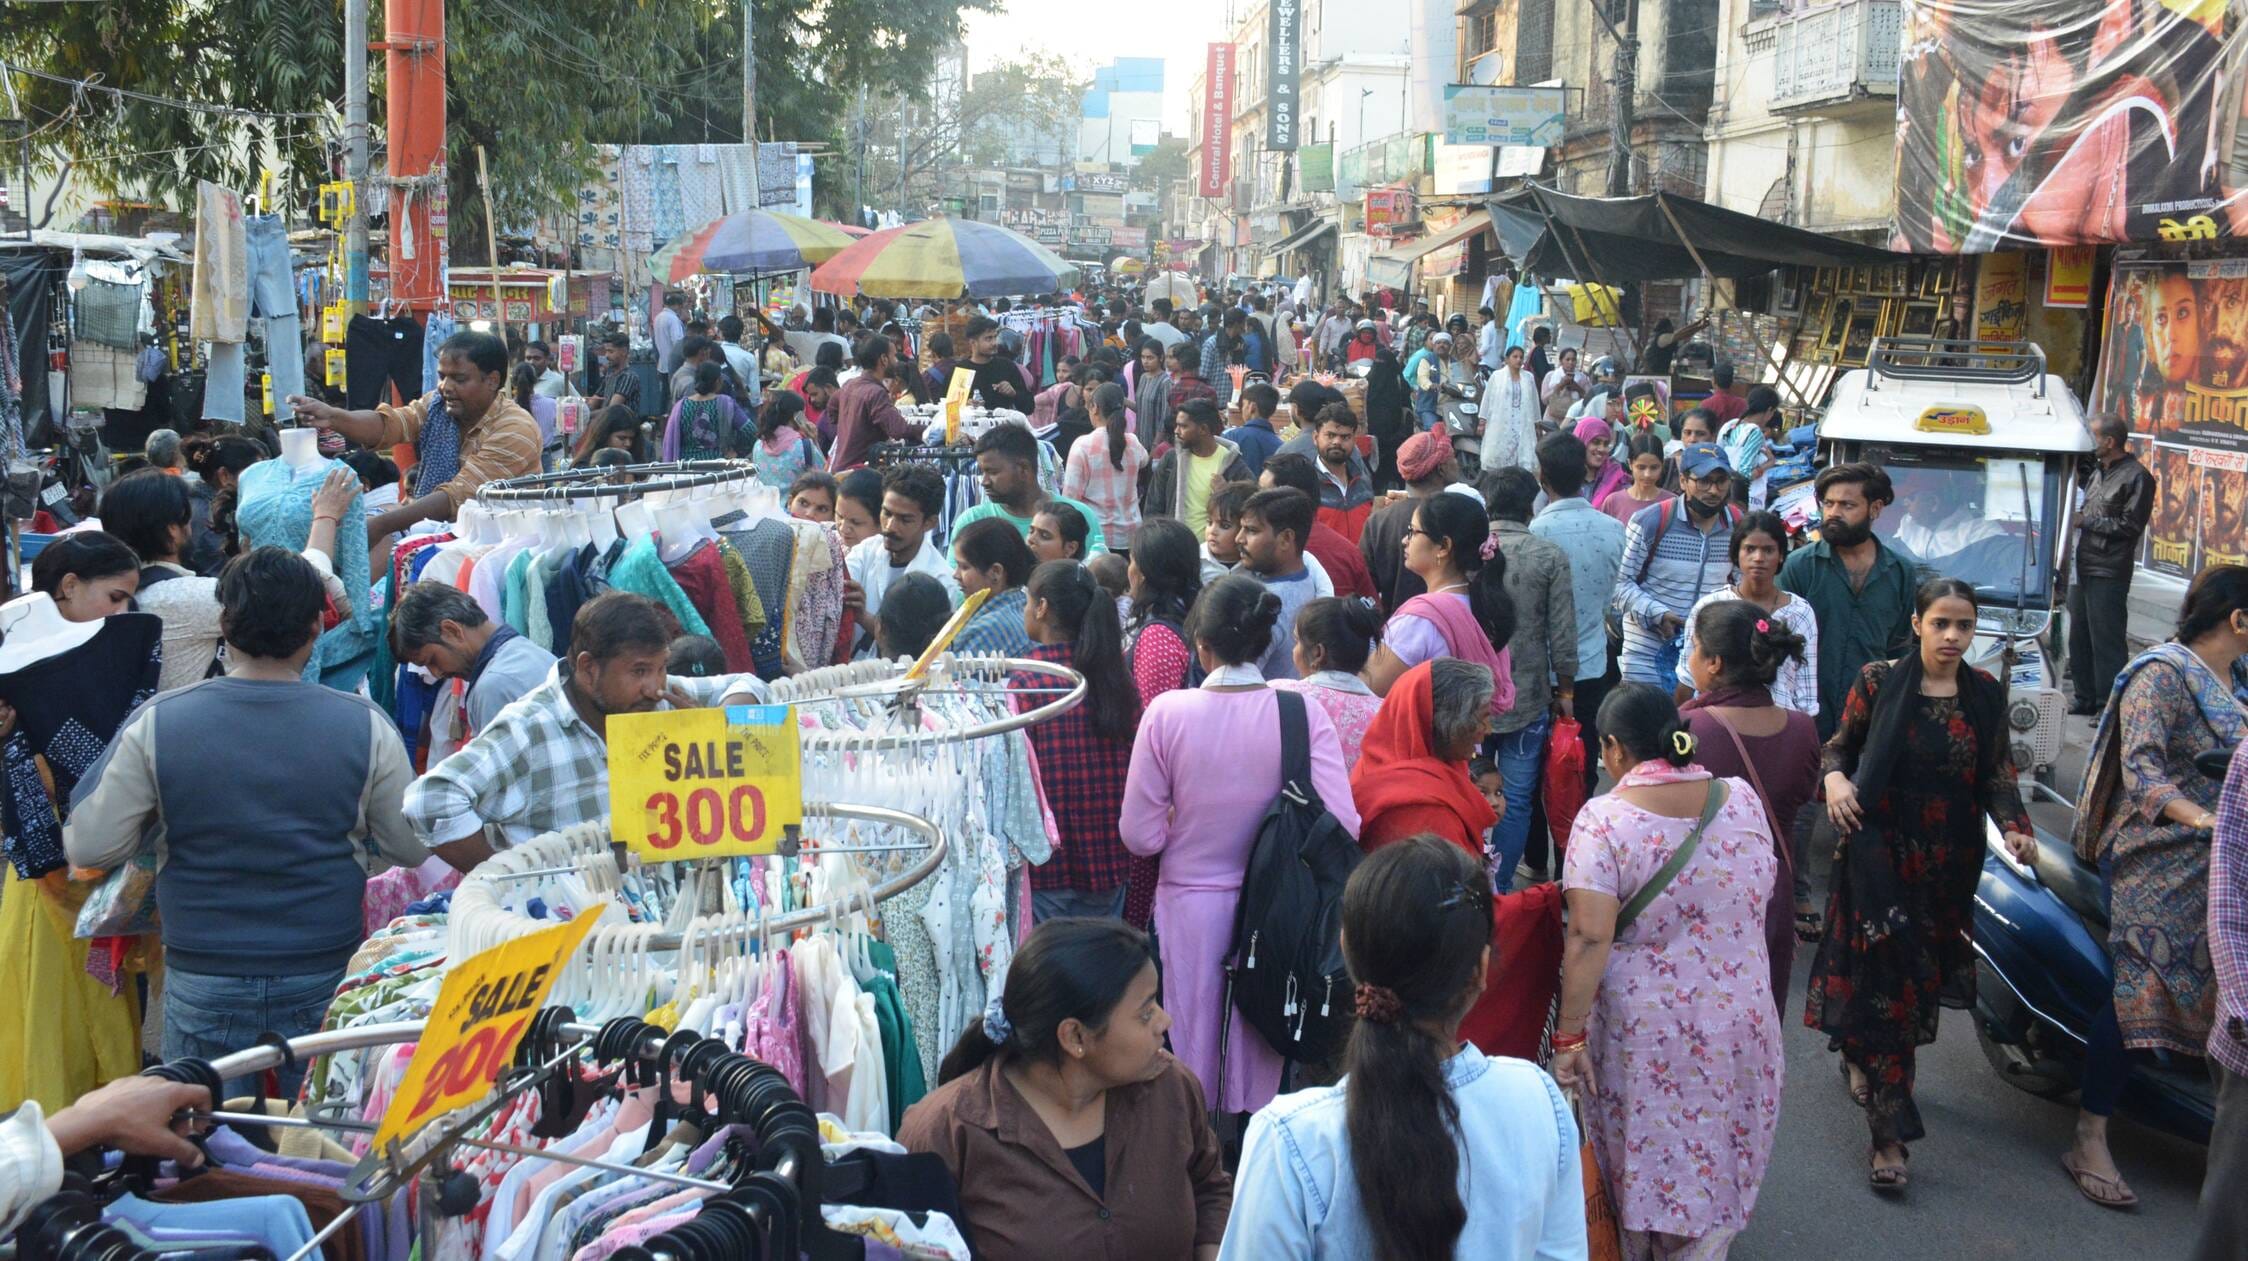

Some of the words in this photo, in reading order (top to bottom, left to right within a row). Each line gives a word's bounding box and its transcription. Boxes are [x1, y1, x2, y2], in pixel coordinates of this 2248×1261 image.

[1214, 46, 1226, 99] Banquet
[1277, 84, 1290, 94] &
[1213, 102, 1223, 111] &
[1276, 103, 1290, 143] SONS
[1212, 113, 1223, 144] Hotel
[1210, 147, 1221, 189] Central
[2190, 449, 2204, 463] 26
[2152, 535, 2190, 568] ताकत
[664, 741, 745, 782] SALE
[645, 784, 766, 850] 300
[460, 963, 552, 1035] SALE
